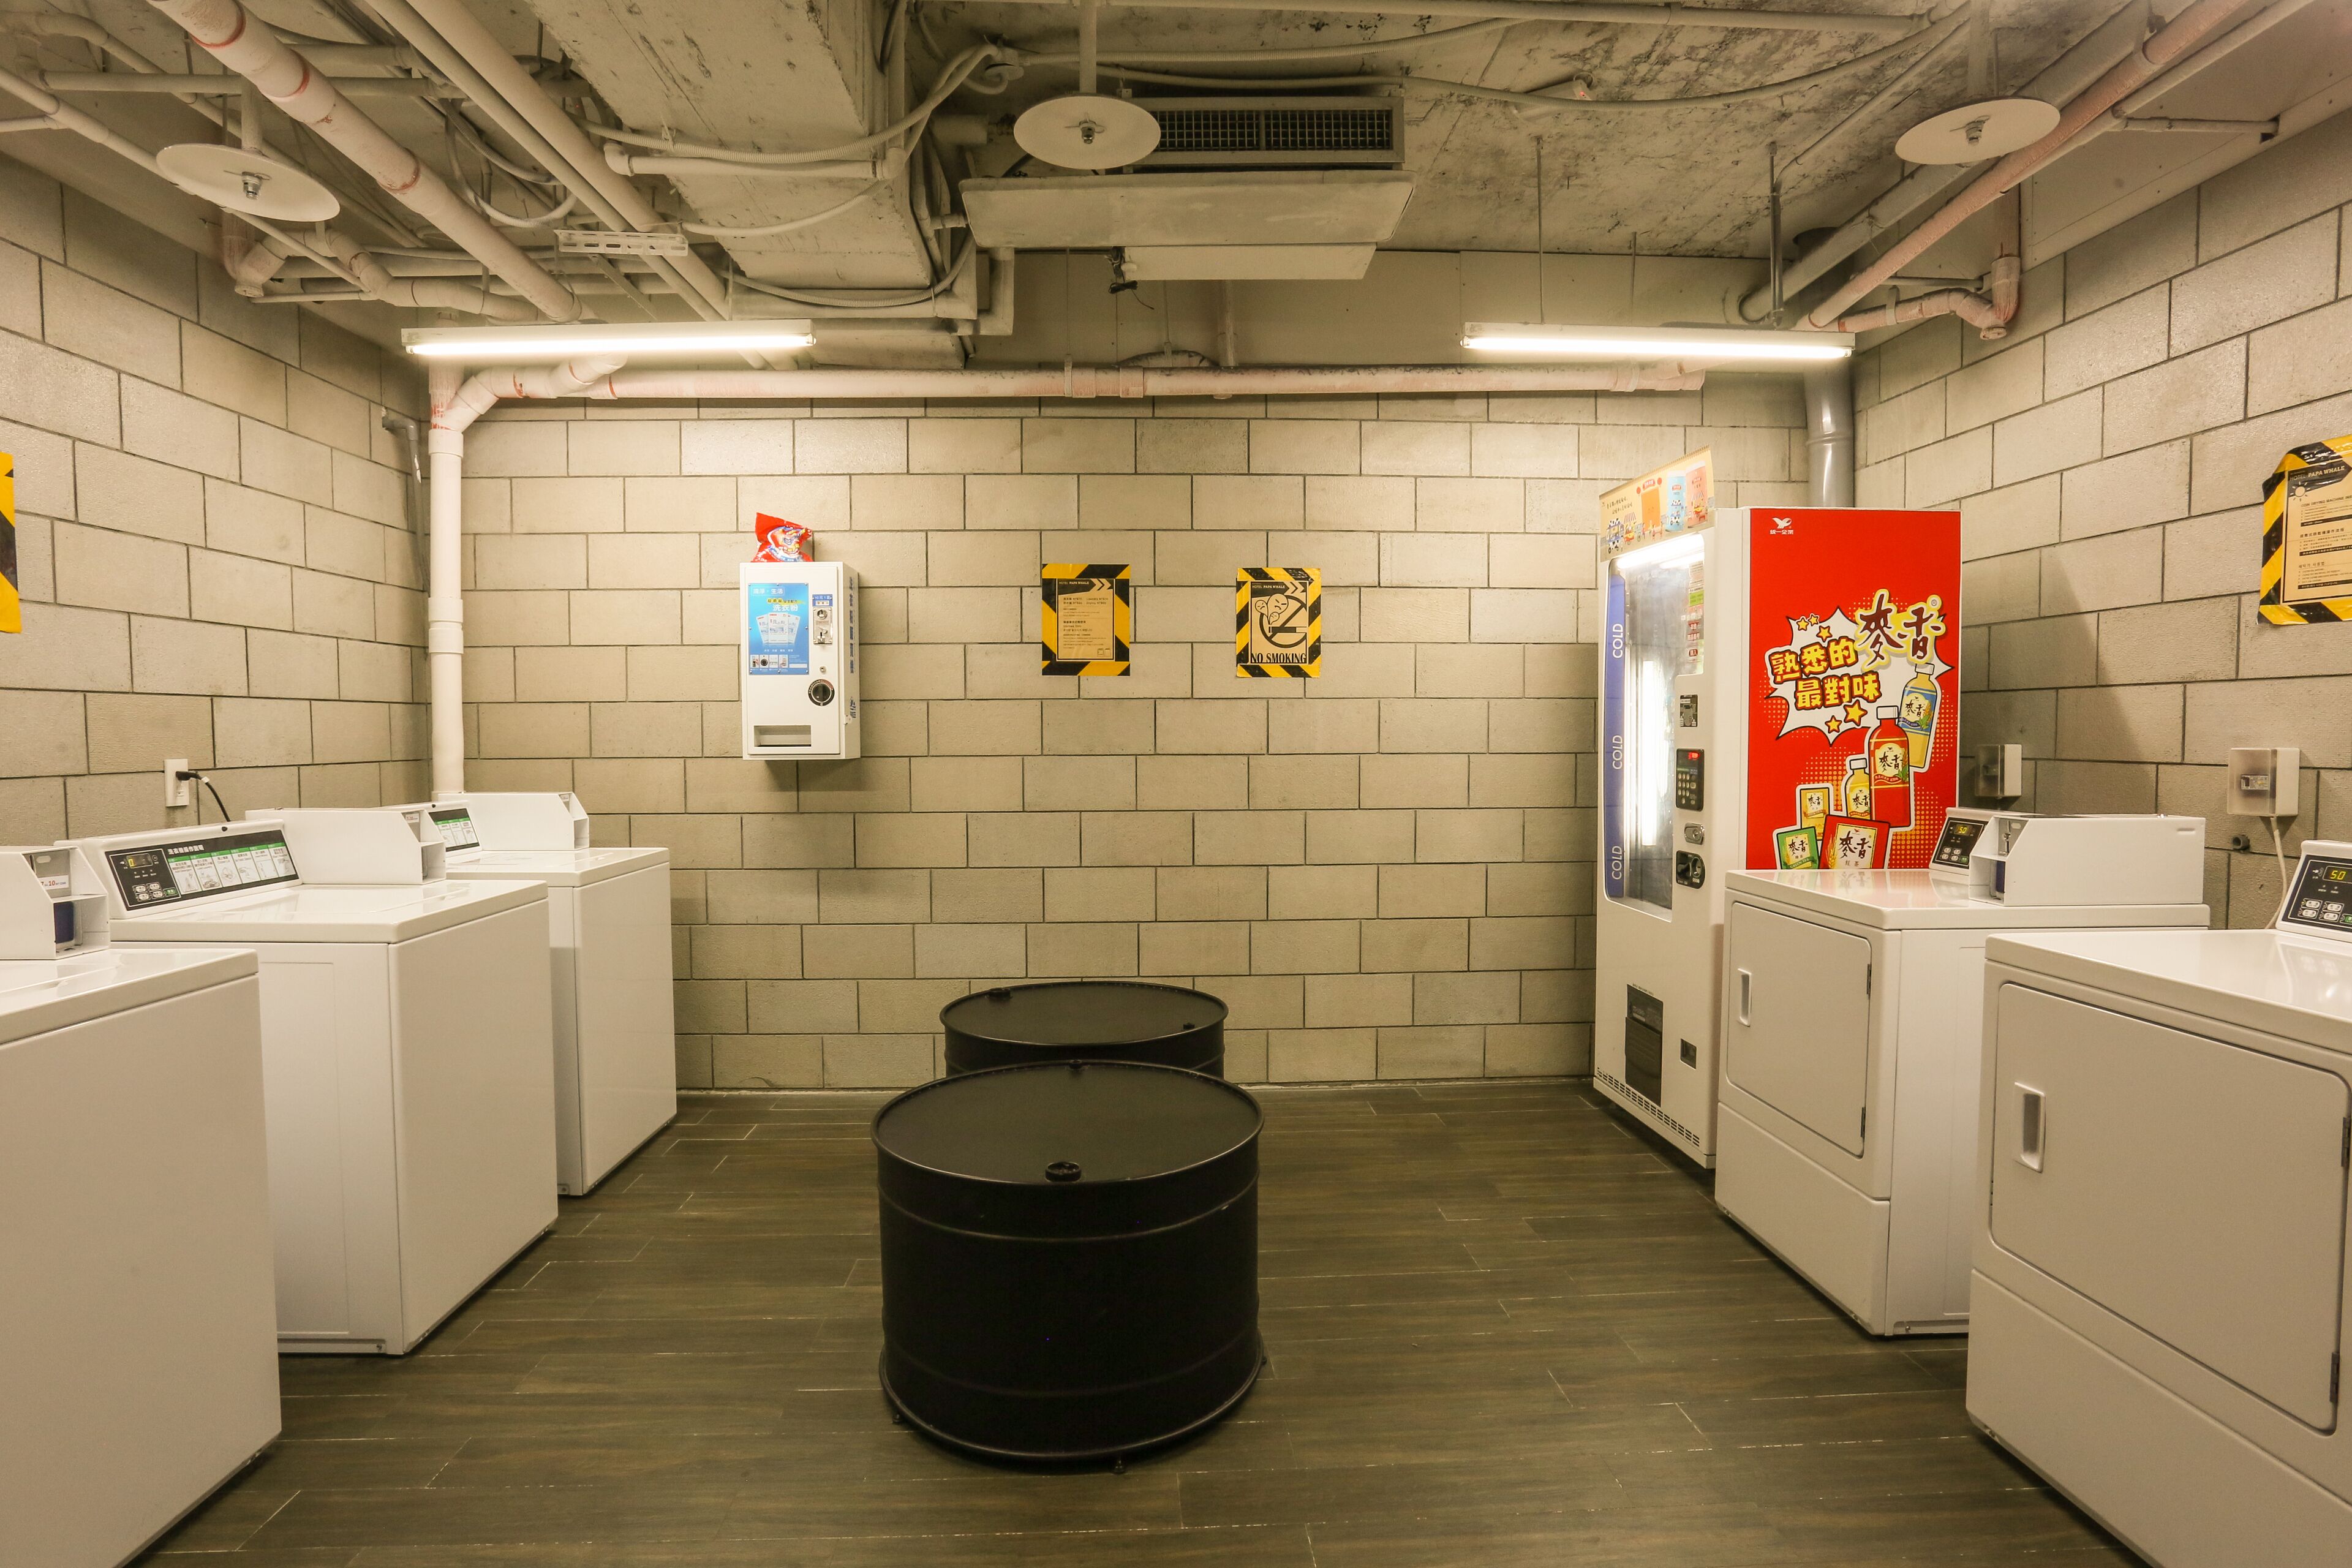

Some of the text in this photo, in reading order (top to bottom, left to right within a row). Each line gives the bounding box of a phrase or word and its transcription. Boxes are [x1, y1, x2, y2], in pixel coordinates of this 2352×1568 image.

[2323, 466, 2345, 475] WHALE
[1612, 623, 1623, 658] COLD
[1858, 593, 1942, 666] 麥香
[1251, 652, 1306, 663] NO SMOKING
[1770, 638, 1856, 683] 熟悉的
[1796, 673, 1881, 709] 最對味
[1905, 699, 1926, 718] 麥香
[1612, 735, 1623, 769] COLD
[1879, 751, 1903, 773] 麥香
[1807, 794, 1823, 807] 麥香
[1852, 793, 1870, 810] 麥香
[1788, 839, 1808, 856] 麥香
[1838, 830, 1872, 859] 麥香
[1611, 846, 1623, 880] COLD
[2329, 870, 2346, 880] 50
